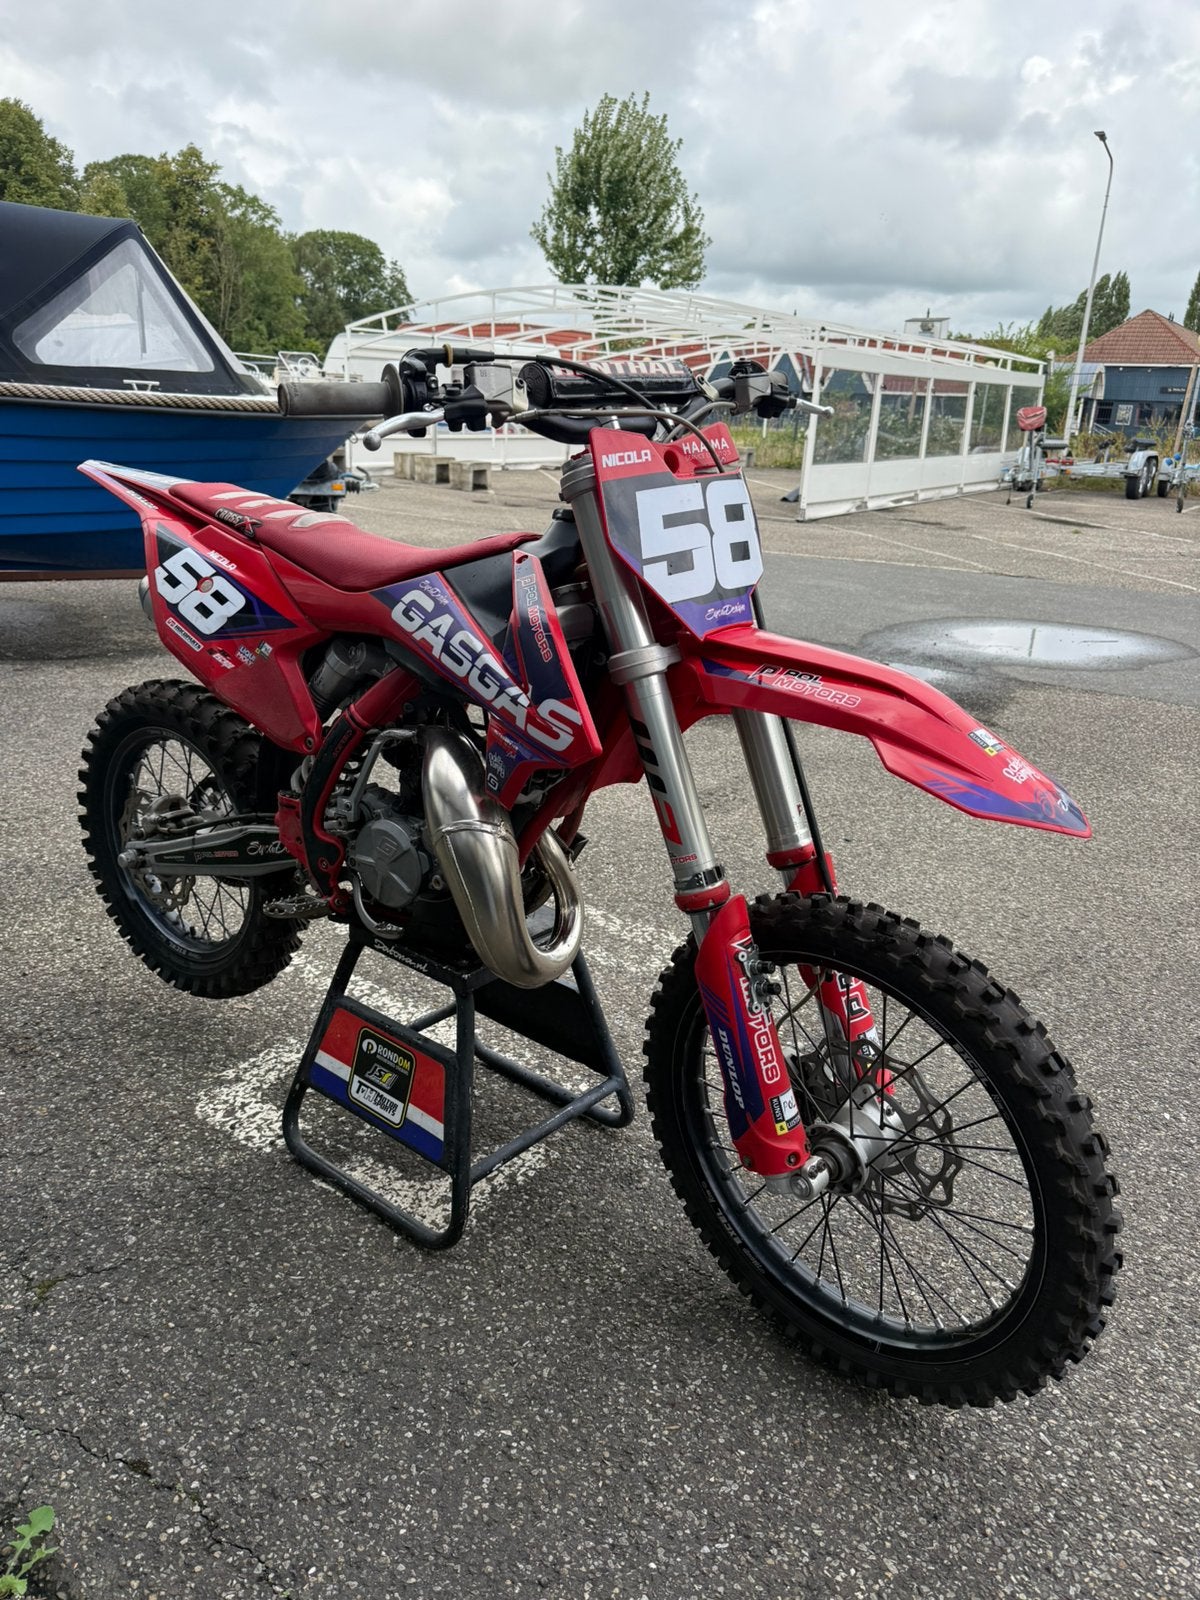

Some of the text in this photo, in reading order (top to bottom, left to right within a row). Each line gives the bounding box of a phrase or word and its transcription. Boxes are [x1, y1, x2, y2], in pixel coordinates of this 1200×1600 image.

[551, 360, 685, 378] RNTHAL
[601, 449, 651, 469] NICOLA
[682, 437, 729, 455] HAAMA
[635, 479, 764, 603] 58
[154, 547, 246, 635] 58
[527, 604, 553, 663] MOTORS
[391, 589, 582, 752] GASGAS
[783, 668, 823, 686] POL
[772, 677, 861, 708] MOTORS
[739, 976, 781, 1085] OTORS
[377, 1044, 411, 1071] RONDOM
[718, 1027, 745, 1110] DUNLOP
[772, 1098, 783, 1121] KUNST
